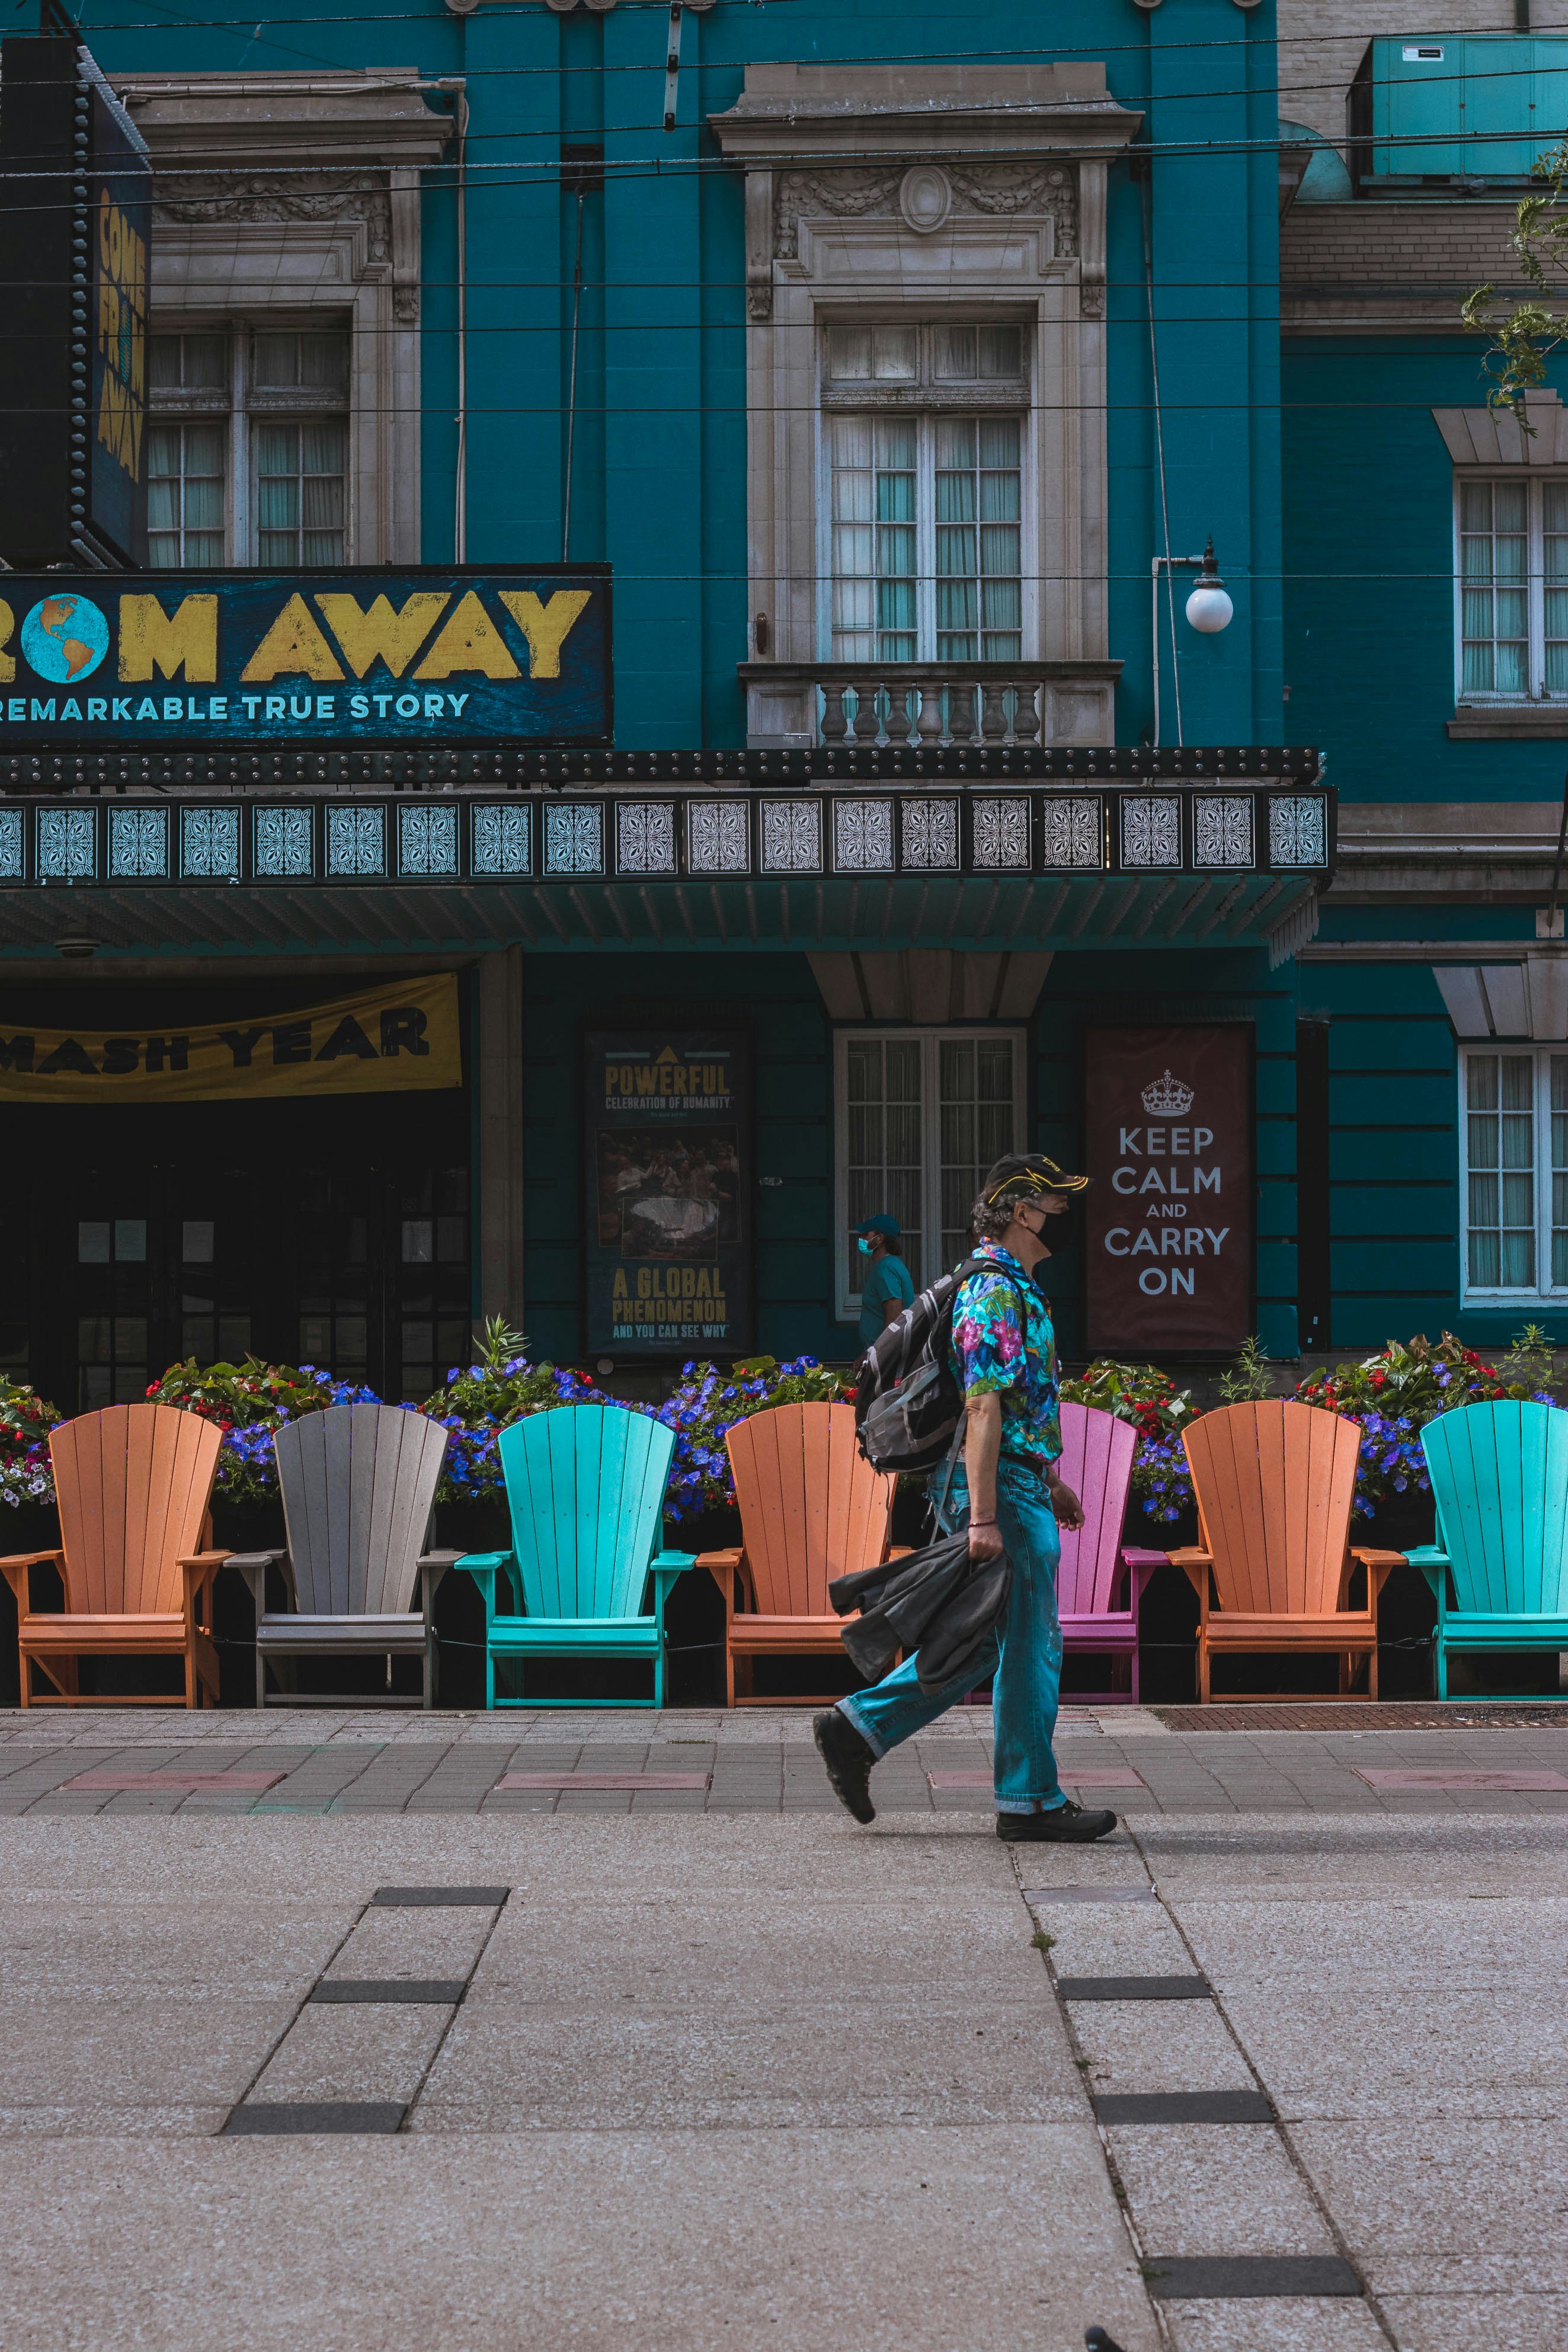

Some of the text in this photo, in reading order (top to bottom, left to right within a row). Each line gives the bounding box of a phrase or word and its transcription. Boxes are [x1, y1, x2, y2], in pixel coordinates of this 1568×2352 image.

[100, 187, 145, 321] COME
[97, 363, 143, 484] AWAY
[0, 590, 592, 683] OM AWAY
[0, 693, 470, 721] EMARKABLE TRUE STORY
[217, 1007, 429, 1067] YEAR
[605, 1064, 731, 1096] POWERFUL
[606, 1097, 665, 1109] CELEBRATION
[669, 1097, 680, 1109] OF
[1119, 1128, 1214, 1154] KEEP
[1112, 1166, 1221, 1194] CALM
[1146, 1204, 1187, 1218] AND
[1104, 1227, 1230, 1256] CARRY
[613, 1267, 726, 1298] A GLOBAL
[1138, 1268, 1195, 1295] ON
[613, 1325, 633, 1338] AND
[635, 1325, 655, 1337] YOU
[658, 1325, 678, 1337] CAN
[681, 1324, 699, 1337] SEE
